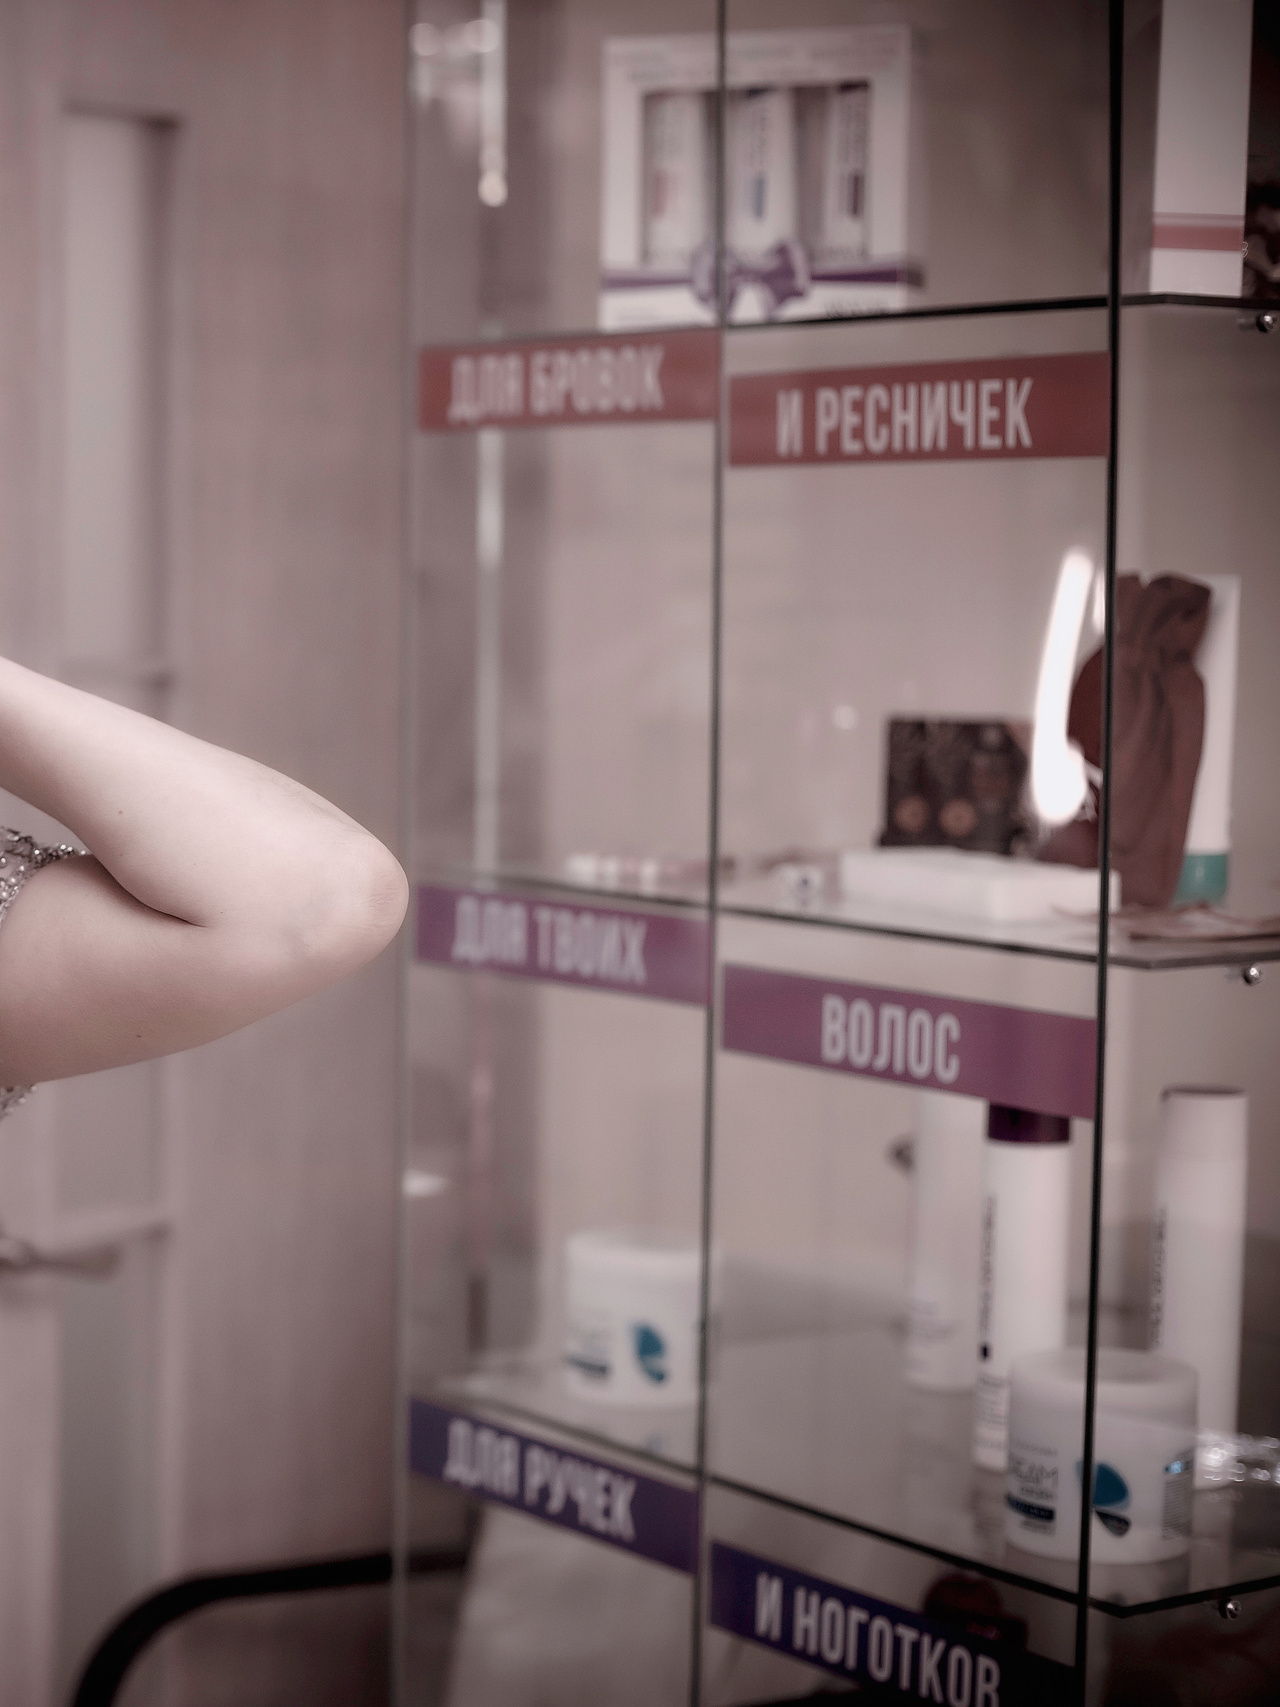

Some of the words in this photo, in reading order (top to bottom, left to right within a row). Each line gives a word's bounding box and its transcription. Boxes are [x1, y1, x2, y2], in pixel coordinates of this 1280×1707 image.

[447, 353, 523, 424] ДЛЯ
[529, 345, 665, 416] БРОВОК
[776, 387, 804, 457] И
[815, 376, 1034, 456] РЕСНИЧЕК
[451, 895, 527, 966] ДЛЯ
[534, 905, 648, 986] ТВОИХ
[821, 993, 962, 1084] ВОЛОС
[443, 1417, 520, 1500] ДЛЯ
[523, 1444, 637, 1543] РУЧЕК
[755, 1571, 783, 1642] И
[792, 1585, 1001, 1707] НОГОТКОВ
